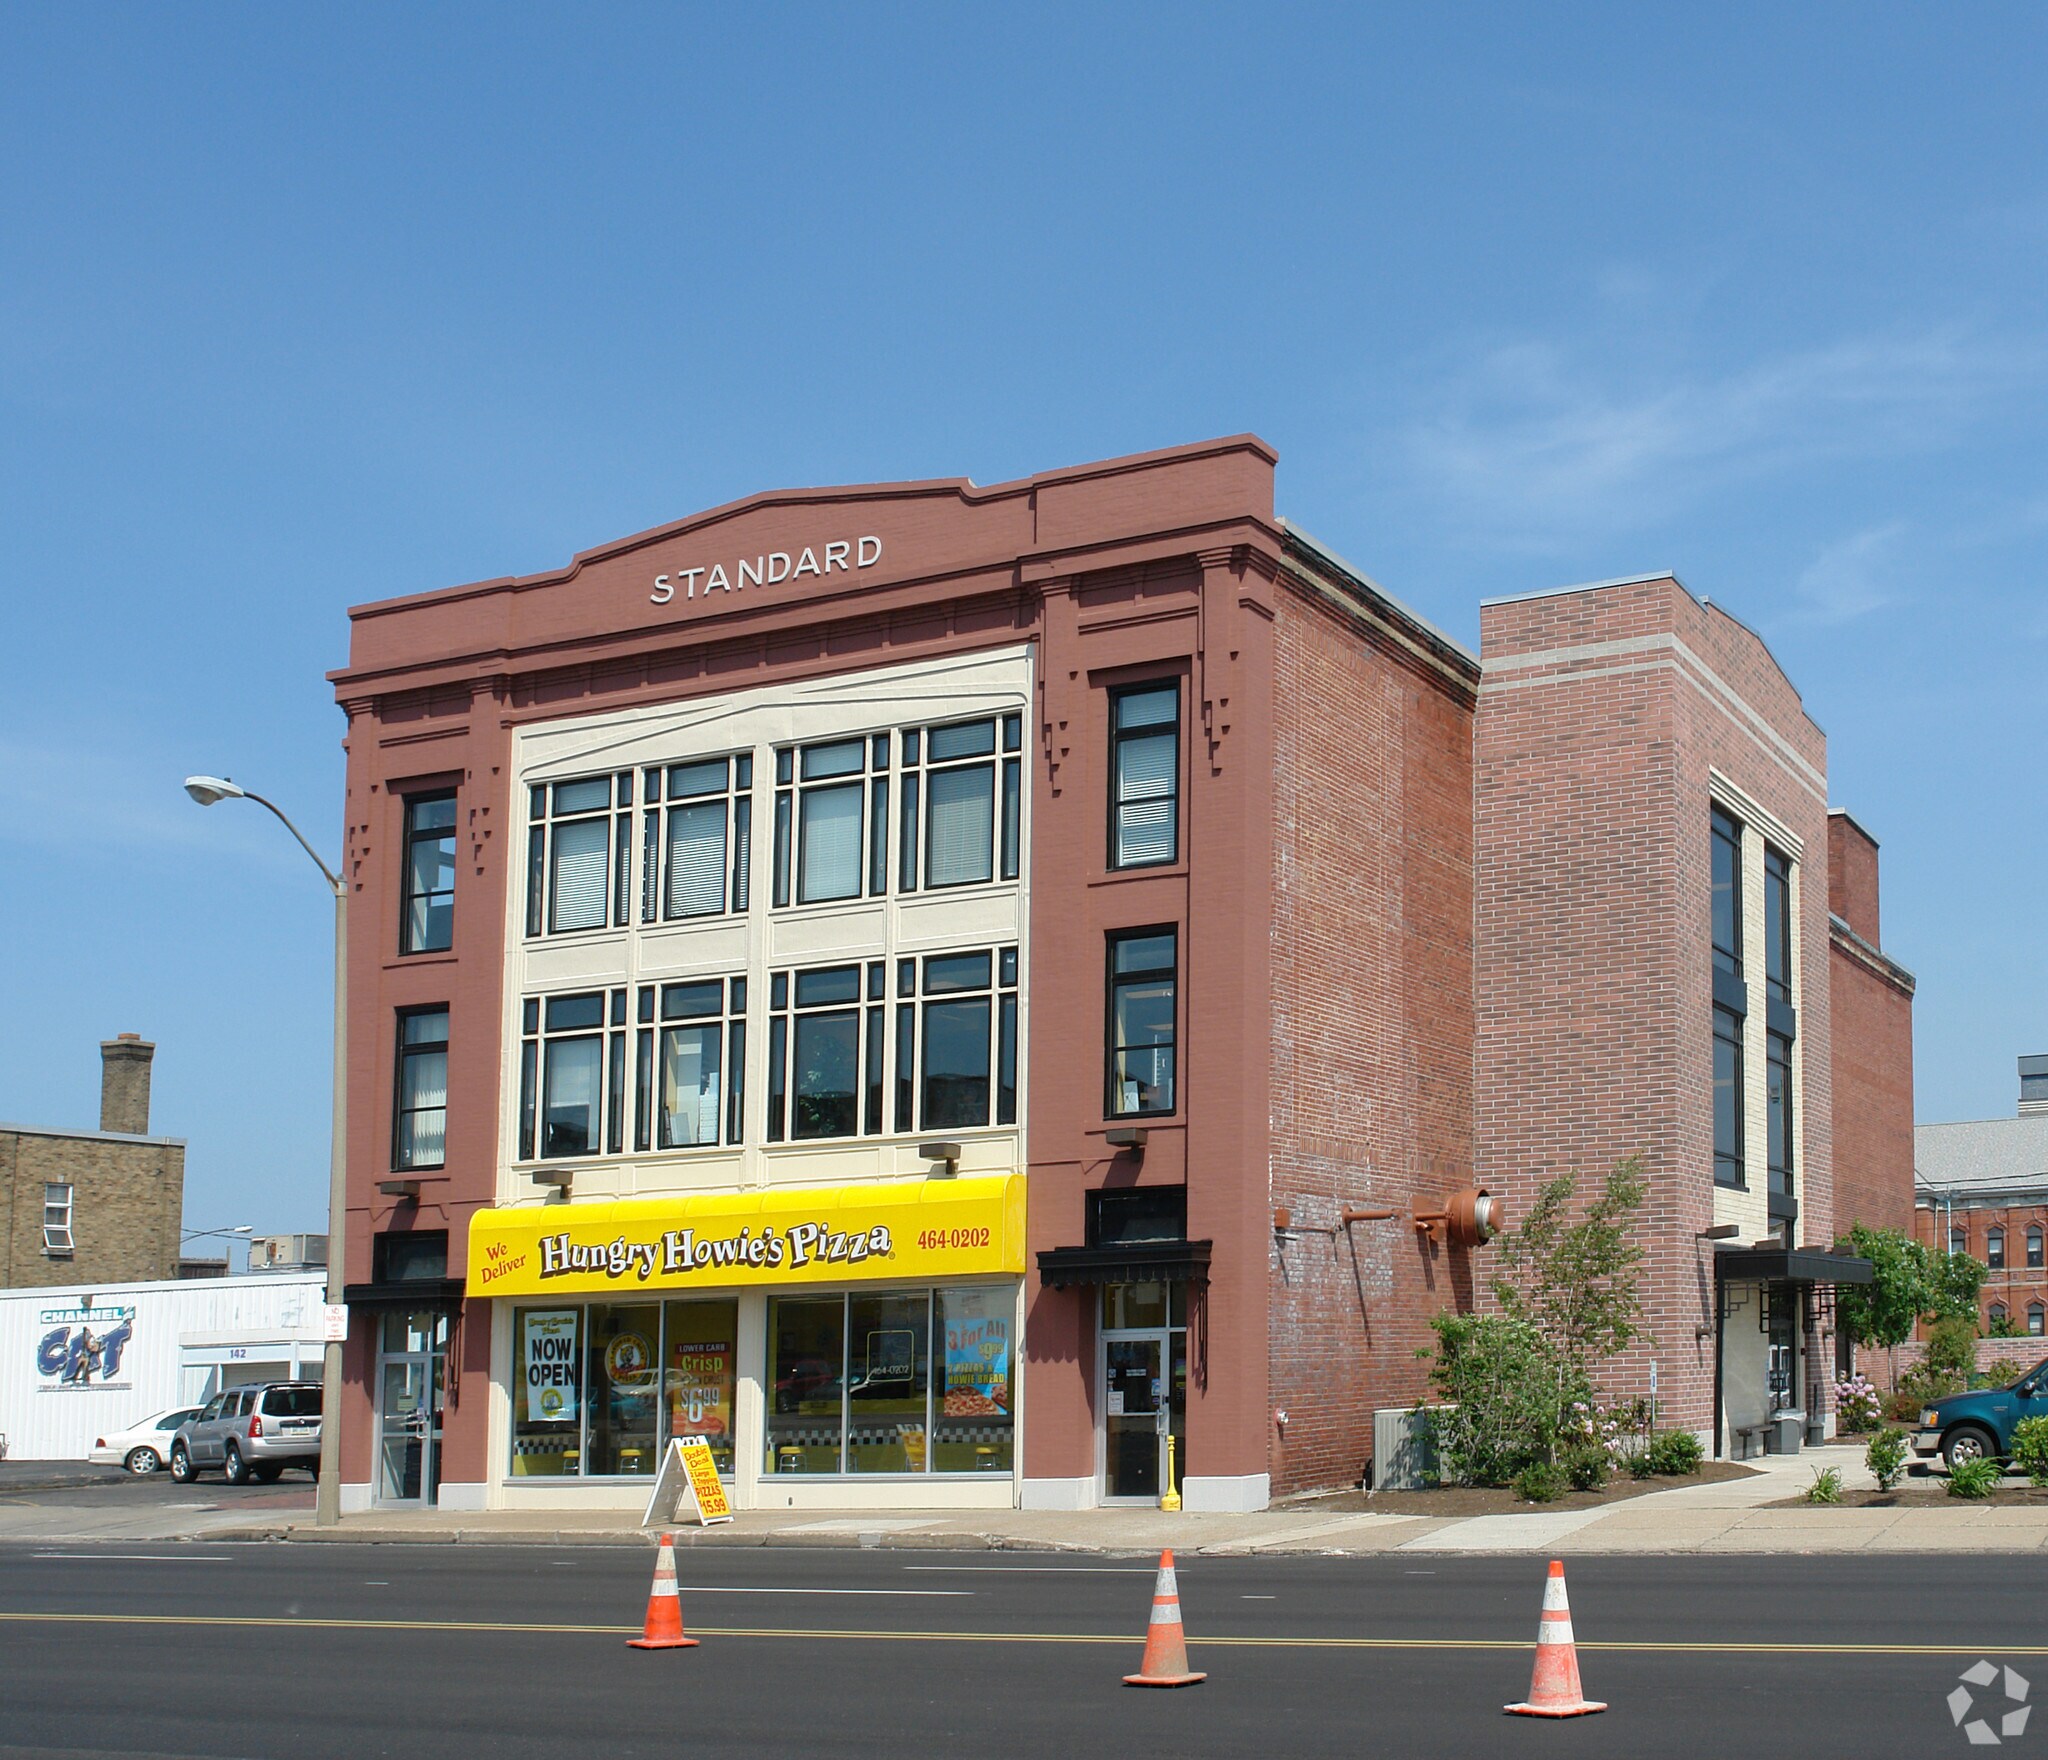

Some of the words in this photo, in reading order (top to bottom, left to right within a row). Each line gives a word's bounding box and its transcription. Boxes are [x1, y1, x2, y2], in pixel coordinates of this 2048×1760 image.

[650, 535, 882, 603] STANDARD
[917, 1227, 990, 1250] 464-0202
[485, 1242, 508, 1262] We
[539, 1232, 660, 1282] Hungry
[661, 1226, 785, 1276] Howie's
[786, 1222, 892, 1270] Pizza
[481, 1254, 527, 1285] Deliver
[41, 1308, 122, 1323] CHANNEL
[230, 1348, 246, 1359] 142
[532, 1338, 572, 1362] NOW
[679, 1343, 704, 1353] LOWER
[705, 1343, 726, 1352] CARB
[681, 1354, 724, 1373] Crisp
[528, 1363, 576, 1388] OPEN
[948, 1374, 975, 1385] HOWIE
[977, 1373, 1005, 1384] BREAD
[684, 1447, 707, 1461] Double
[689, 1455, 709, 1468] Deal
[695, 1485, 722, 1498] PIZZAS
